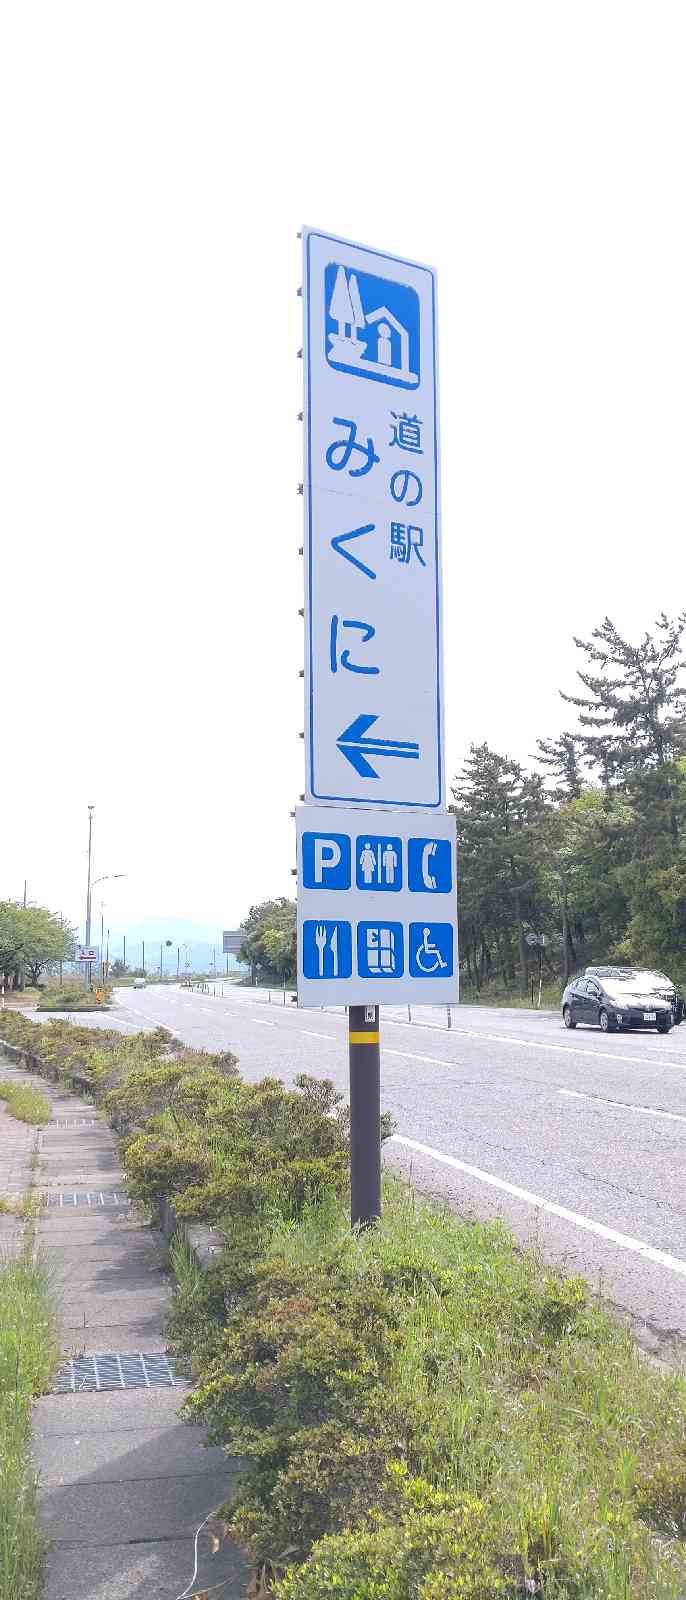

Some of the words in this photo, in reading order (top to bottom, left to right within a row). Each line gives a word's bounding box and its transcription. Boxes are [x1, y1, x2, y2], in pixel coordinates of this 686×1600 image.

[326, 416, 380, 674] みくに
[389, 410, 426, 567] 道の駅
[314, 839, 341, 883] P
